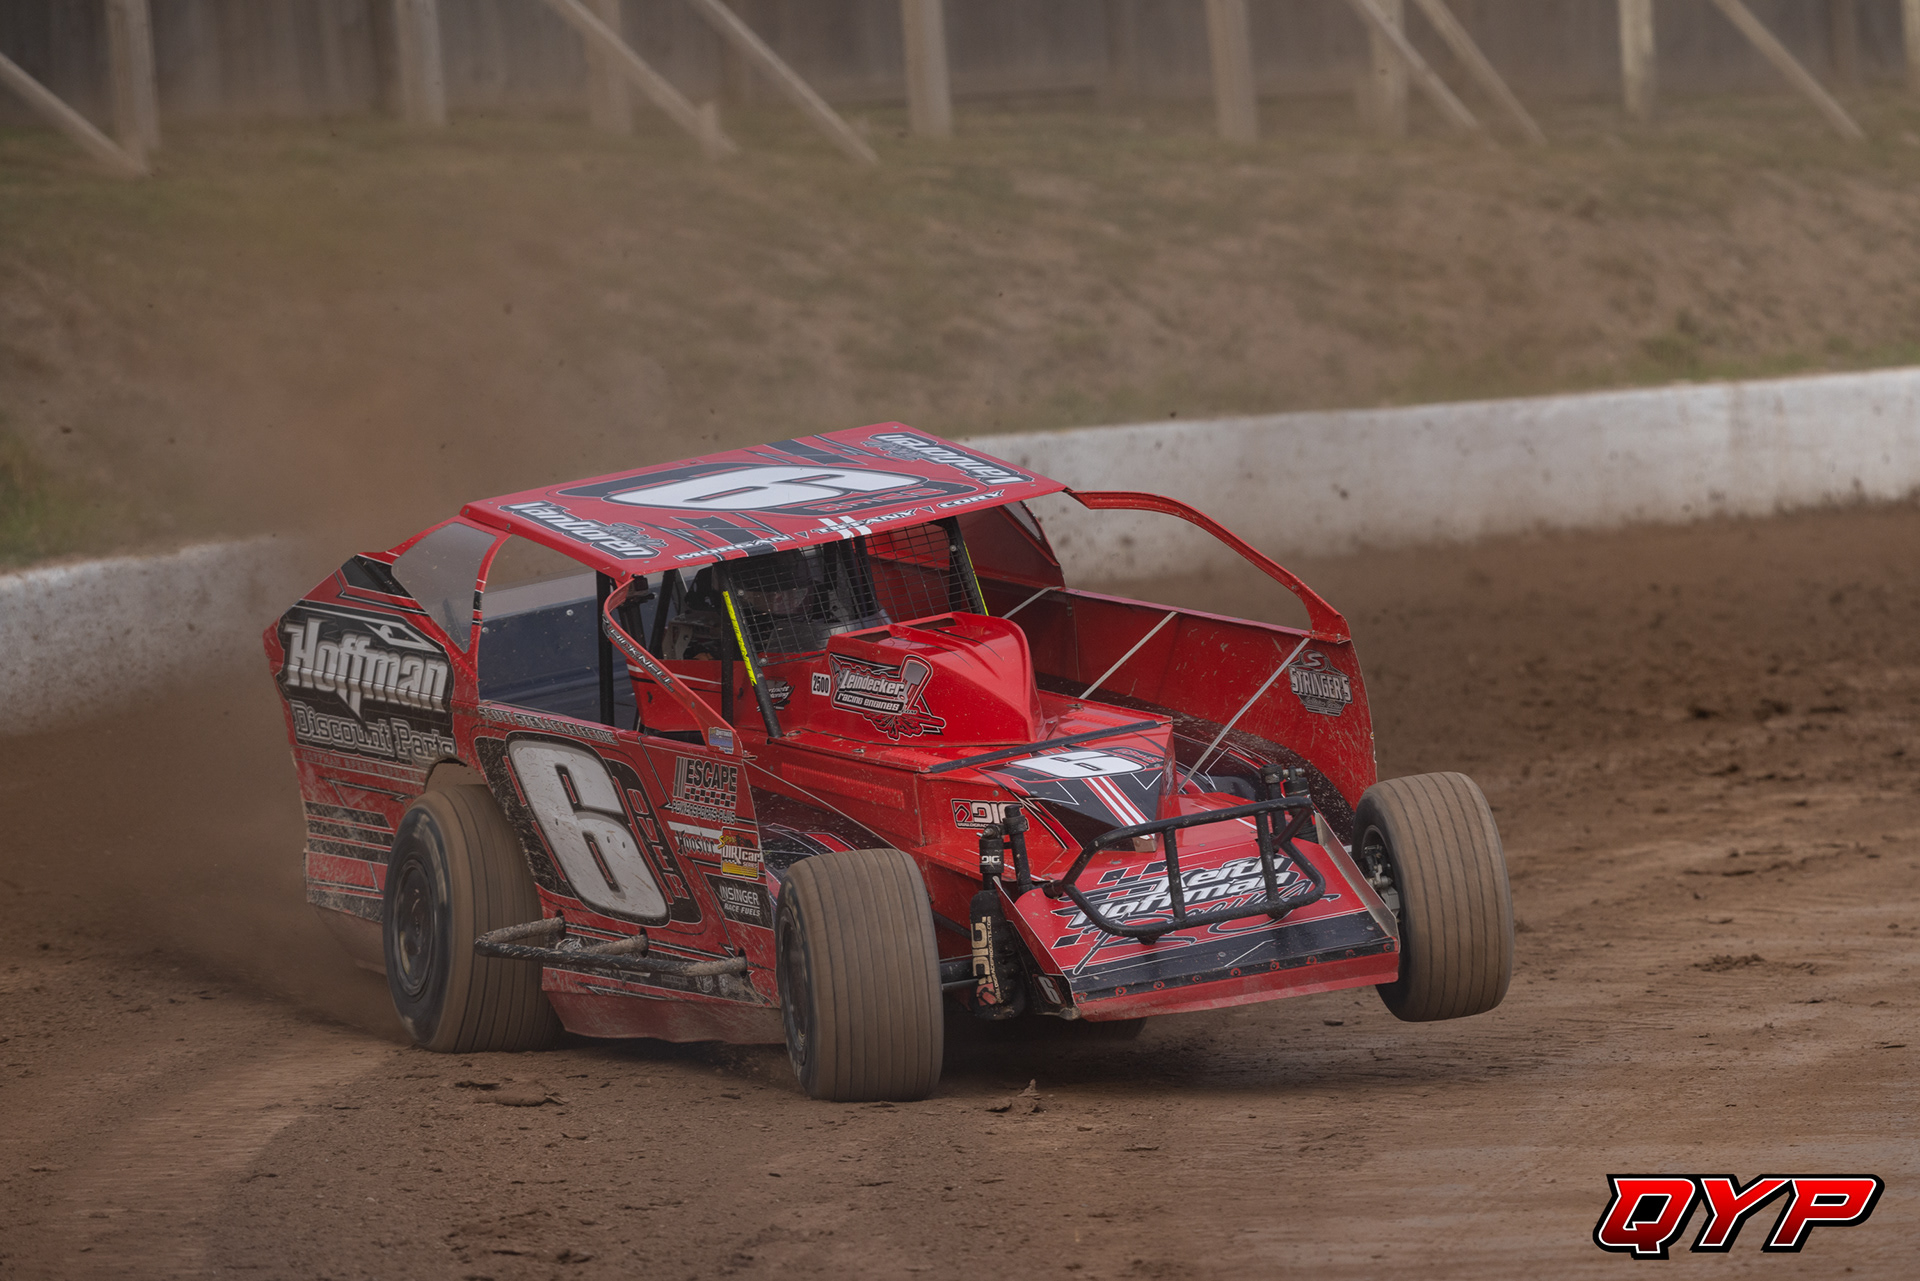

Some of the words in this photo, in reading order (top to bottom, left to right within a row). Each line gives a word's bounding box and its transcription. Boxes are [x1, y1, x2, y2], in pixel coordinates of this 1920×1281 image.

[608, 466, 916, 509] 6
[675, 534, 793, 561] MORGAN
[937, 489, 1004, 510] CORY
[283, 617, 448, 718] Hoffman
[839, 668, 905, 696] Leindecker
[813, 674, 830, 694] 2500
[291, 700, 396, 758] Discount
[391, 718, 457, 768] Parts
[686, 759, 738, 793] ESCAPE
[1009, 750, 1145, 779] 6
[508, 740, 669, 919] 6
[675, 829, 717, 856] Hoosier
[720, 886, 760, 905] INSINGER
[724, 902, 740, 913] RACE
[740, 905, 761, 917] FUELS
[1037, 975, 1062, 1005] 6
